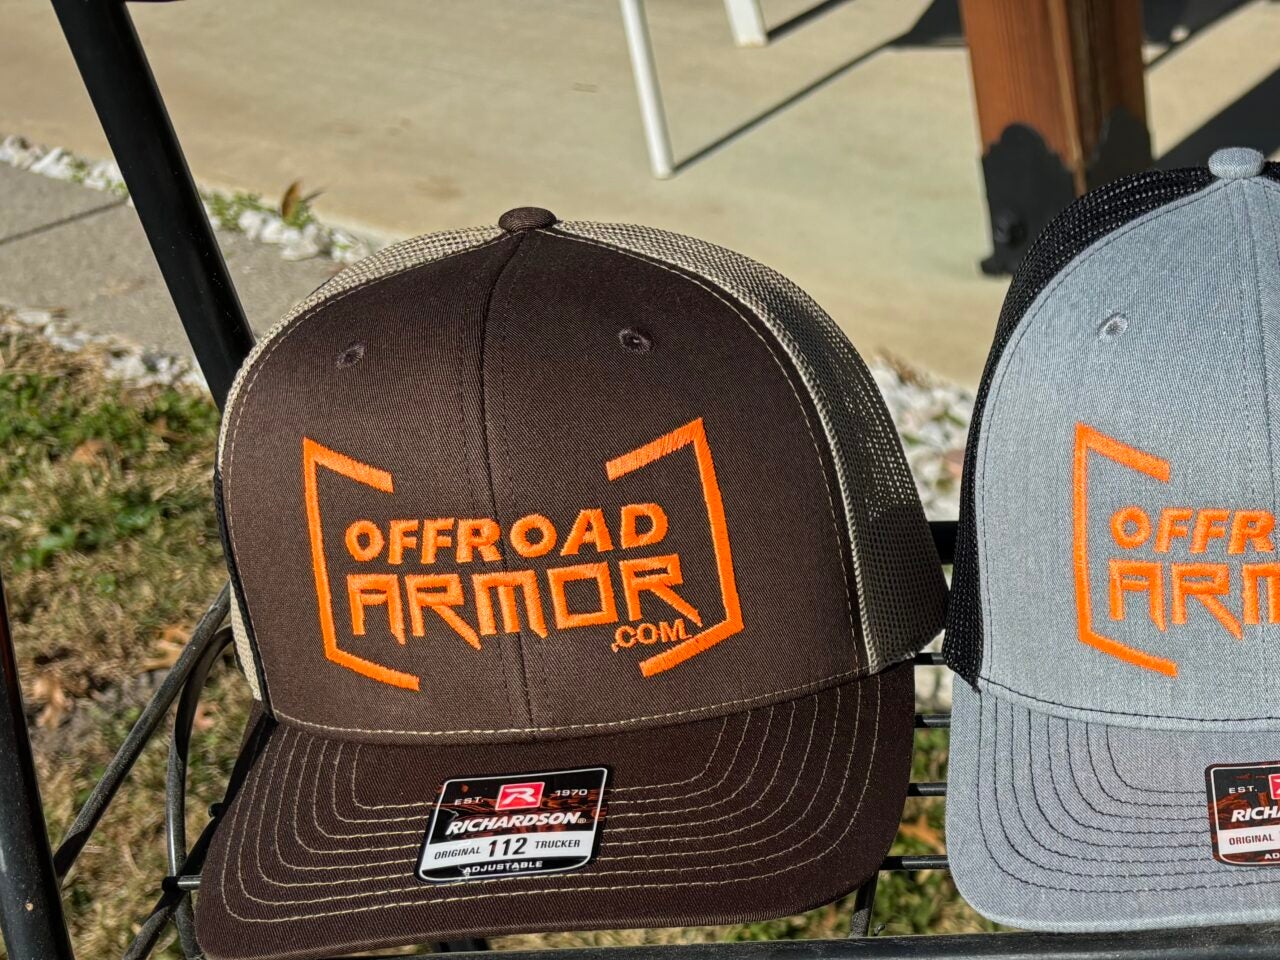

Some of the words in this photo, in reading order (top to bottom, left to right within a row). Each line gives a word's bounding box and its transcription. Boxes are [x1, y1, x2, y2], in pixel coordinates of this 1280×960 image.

[345, 503, 668, 564] OFFROAD
[346, 553, 702, 650] ARMOR
[434, 846, 481, 860] ORIGINAL
[488, 838, 528, 857] 112
[535, 840, 580, 849] TRUCKER
[1229, 833, 1274, 845] ORIGINAL
[463, 861, 543, 873] ADJUSTABLE
